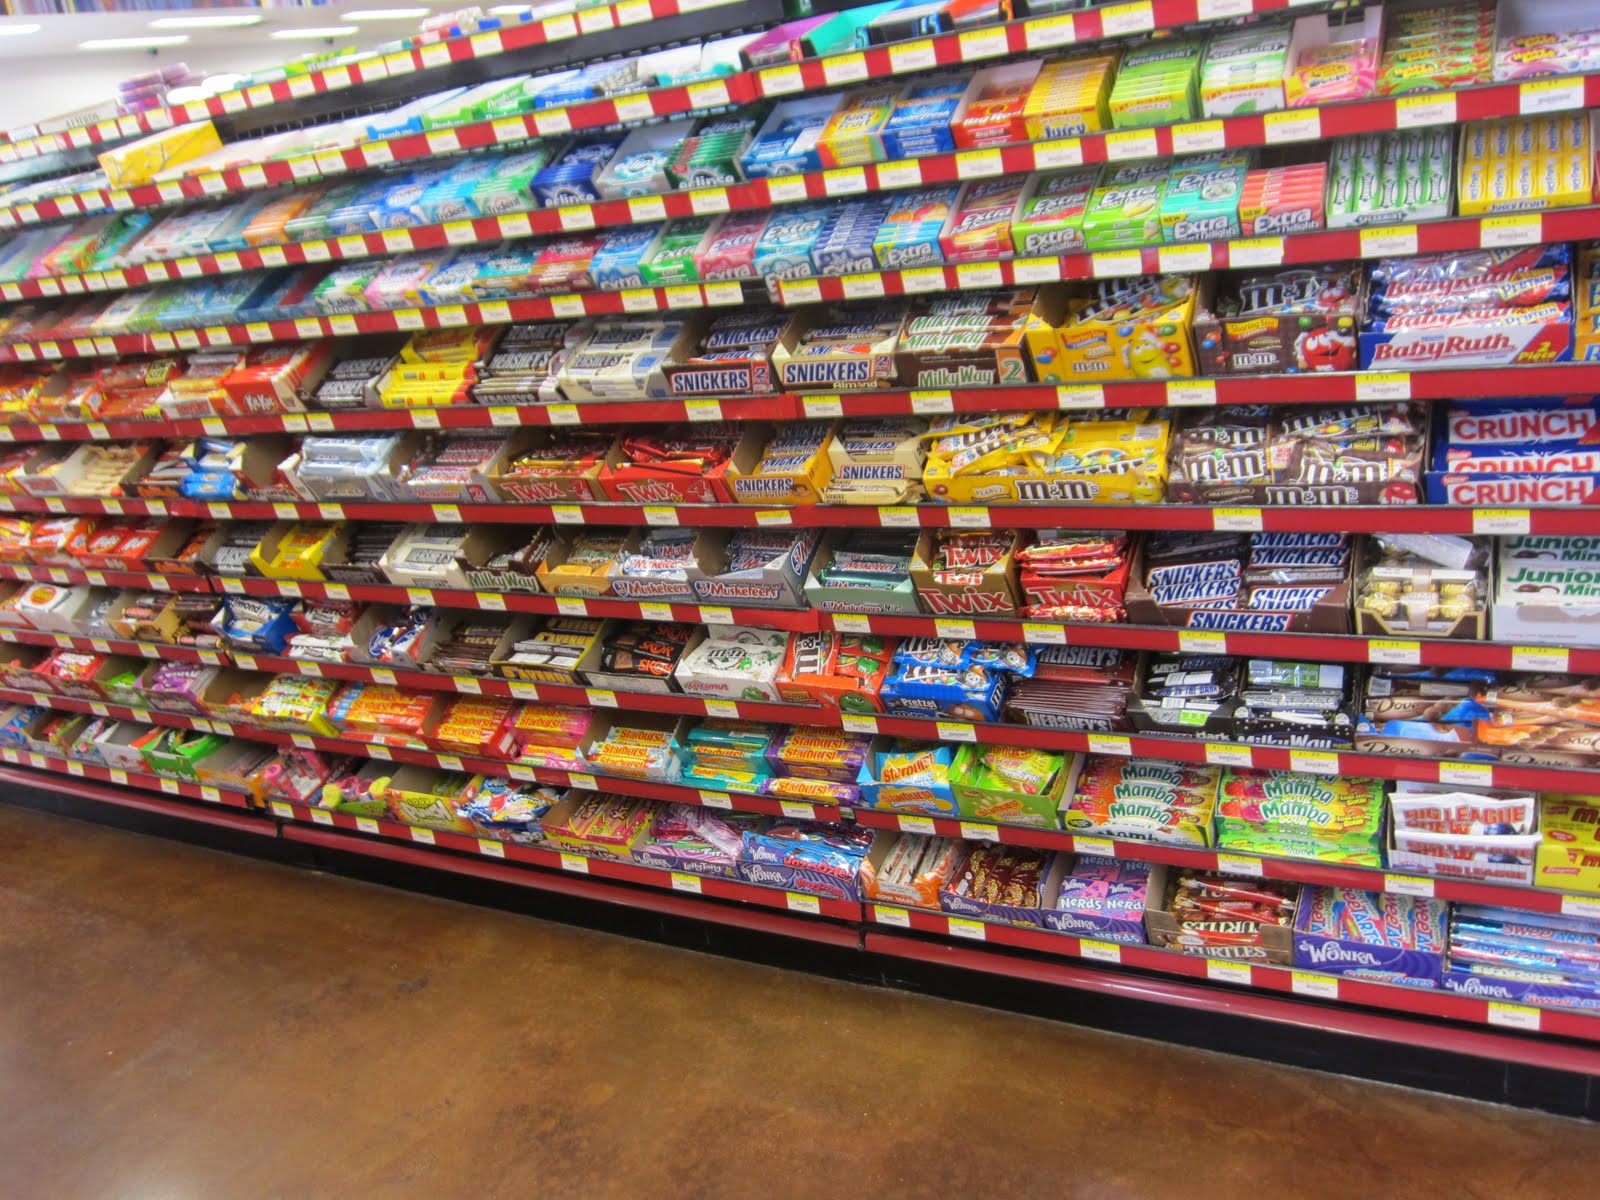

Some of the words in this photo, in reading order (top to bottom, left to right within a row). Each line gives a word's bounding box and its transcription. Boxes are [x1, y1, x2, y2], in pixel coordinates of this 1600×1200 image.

[1178, 168, 1236, 189] Extra
[1102, 185, 1157, 206] Extra
[962, 206, 1012, 227] Extra
[1163, 215, 1182, 224] NEW
[1242, 209, 1262, 218] NEW
[1254, 208, 1312, 234] Extra
[1174, 215, 1229, 240] Extra
[1026, 228, 1076, 250] Extra
[888, 242, 932, 266] Extra
[1230, 321, 1260, 335] Sharing
[1260, 318, 1277, 329] Size
[1538, 341, 1552, 354] 2
[785, 361, 869, 384] SNICKERS
[1000, 357, 1023, 381] 2
[673, 371, 748, 393] SNICKERS
[832, 379, 878, 390] Almond
[1453, 411, 1591, 441] CRUNCH
[841, 465, 903, 480] SNICKERS
[736, 478, 793, 491] SNICKERS
[974, 487, 1004, 497] PEANUT
[1452, 479, 1588, 506] CRUNCH
[1252, 548, 1345, 567] SNICKERS
[1150, 560, 1239, 586] SNICKERS
[627, 579, 691, 598] Musketeers
[709, 582, 778, 600] Musketeers
[1026, 583, 1121, 607] Twix
[1153, 578, 1241, 603] SNICKERS
[918, 586, 1013, 614] Twix
[1251, 588, 1332, 612] SNICKE
[1190, 612, 1291, 631] SNICKERS
[639, 641, 675, 657] SKOR
[1039, 645, 1121, 667] HERSHEY'S
[900, 697, 938, 710] Pretzel
[1376, 697, 1420, 714] Dove
[1027, 712, 1111, 732] HERSHEY'S
[1363, 740, 1421, 755] Dove
[1121, 763, 1184, 786] Mamba
[1115, 784, 1177, 806] Mamba
[1264, 780, 1335, 804] Mamba
[1109, 803, 1172, 826] Mamba
[1261, 801, 1332, 826] Mamba
[1278, 815, 1309, 826] SOUR
[1443, 804, 1527, 824] LEAGUE
[743, 864, 787, 884] WONKA
[1048, 913, 1100, 932] WONKA
[1308, 941, 1382, 966] WONKA
[1452, 978, 1513, 998] WONKA
